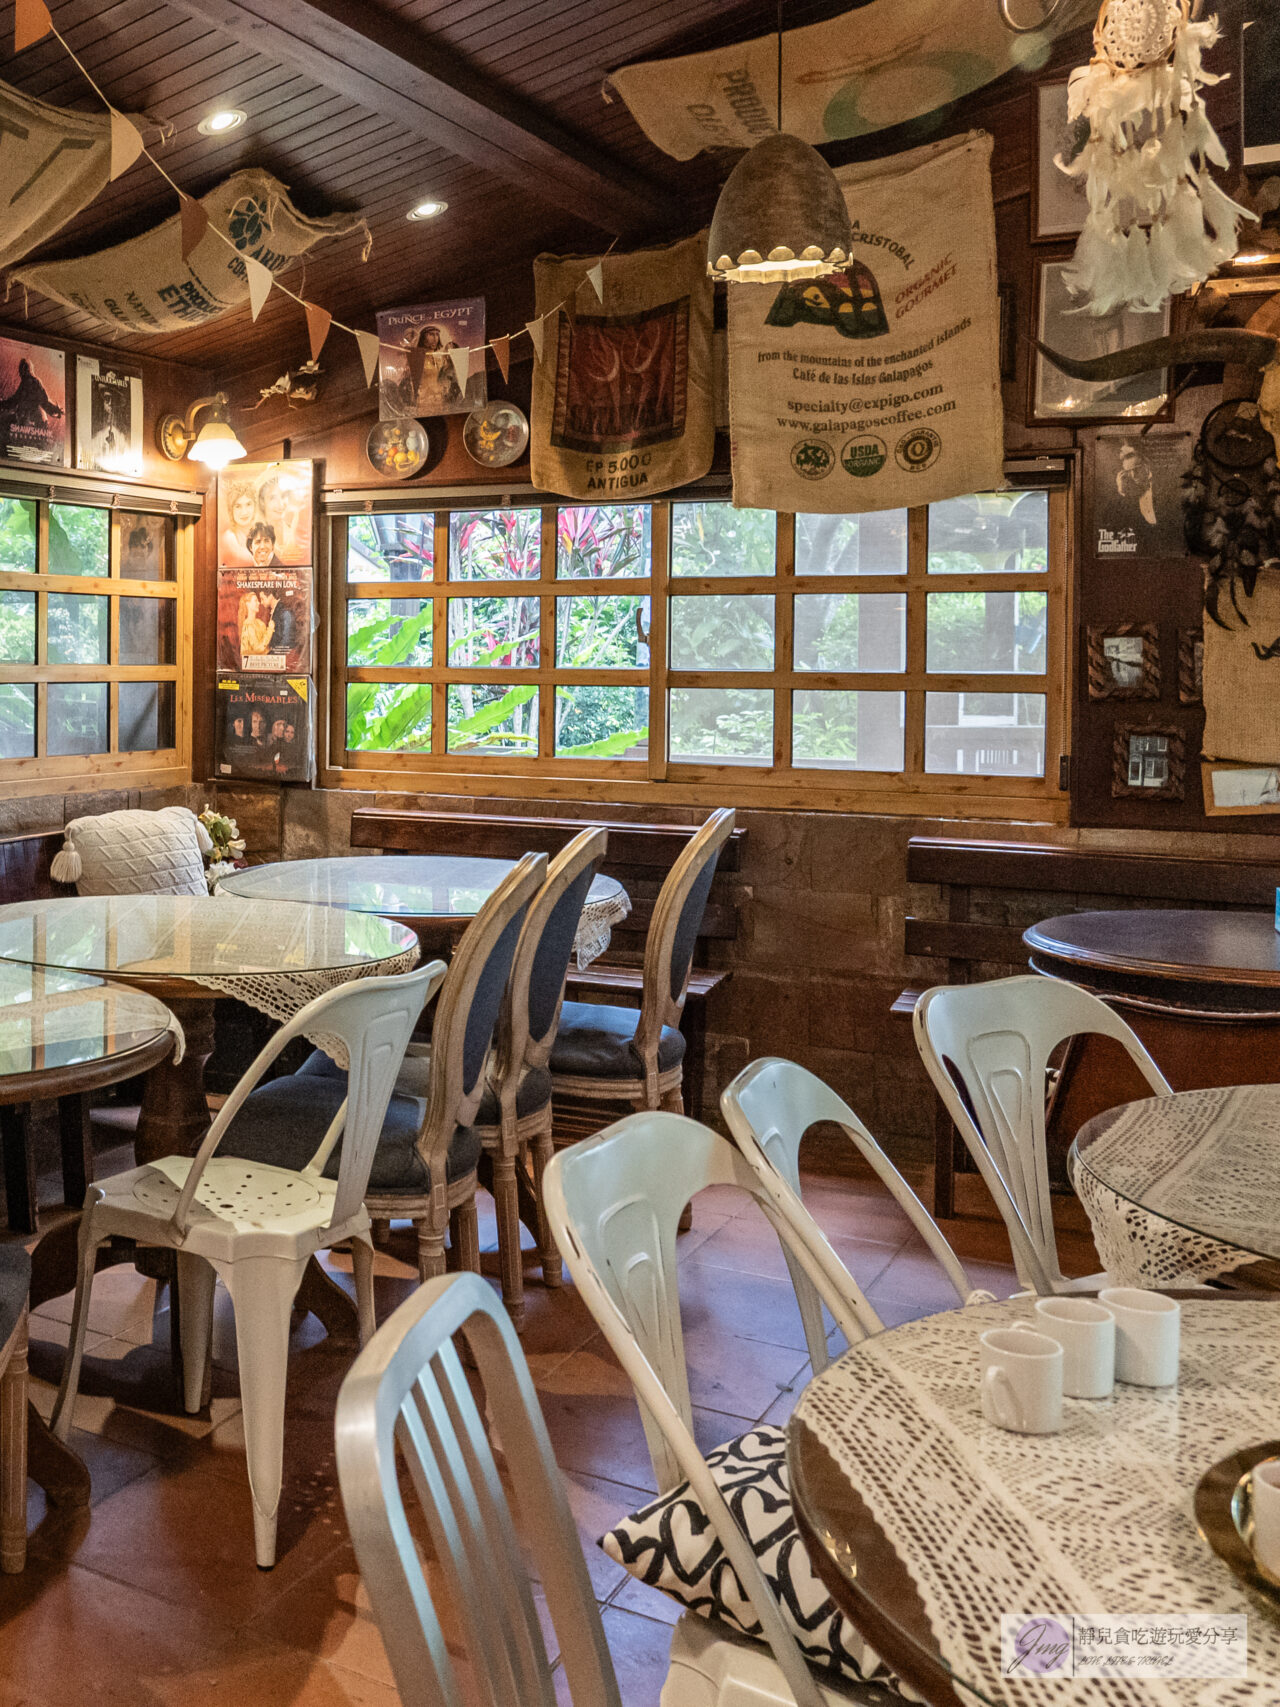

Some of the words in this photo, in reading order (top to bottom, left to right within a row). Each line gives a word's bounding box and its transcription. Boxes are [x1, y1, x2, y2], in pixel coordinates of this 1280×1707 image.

[851, 232, 916, 271] CRISTOBAL
[894, 250, 953, 305] ORGANIC
[895, 262, 958, 320] GOURMET
[433, 305, 474, 320] EGYPT
[757, 350, 780, 363] from
[782, 350, 799, 363] the
[800, 352, 853, 368] mountains
[854, 355, 865, 368] of
[866, 354, 882, 368] the
[883, 338, 935, 366] enchanted
[935, 316, 972, 346] islands
[792, 367, 816, 382] Café
[818, 371, 831, 384] de
[878, 358, 934, 384] Galapagos
[787, 382, 944, 415] specialty@expigo.com
[776, 399, 957, 435] www.galapagoscoffee.com
[849, 443, 880, 459] USDA
[586, 472, 649, 491] ANTIGUA
[1097, 539, 1138, 553] Godfather
[1098, 528, 1114, 540] The
[236, 580, 275, 589] SHAKESPEARE
[275, 580, 282, 588] IN
[282, 580, 298, 588] LOVE
